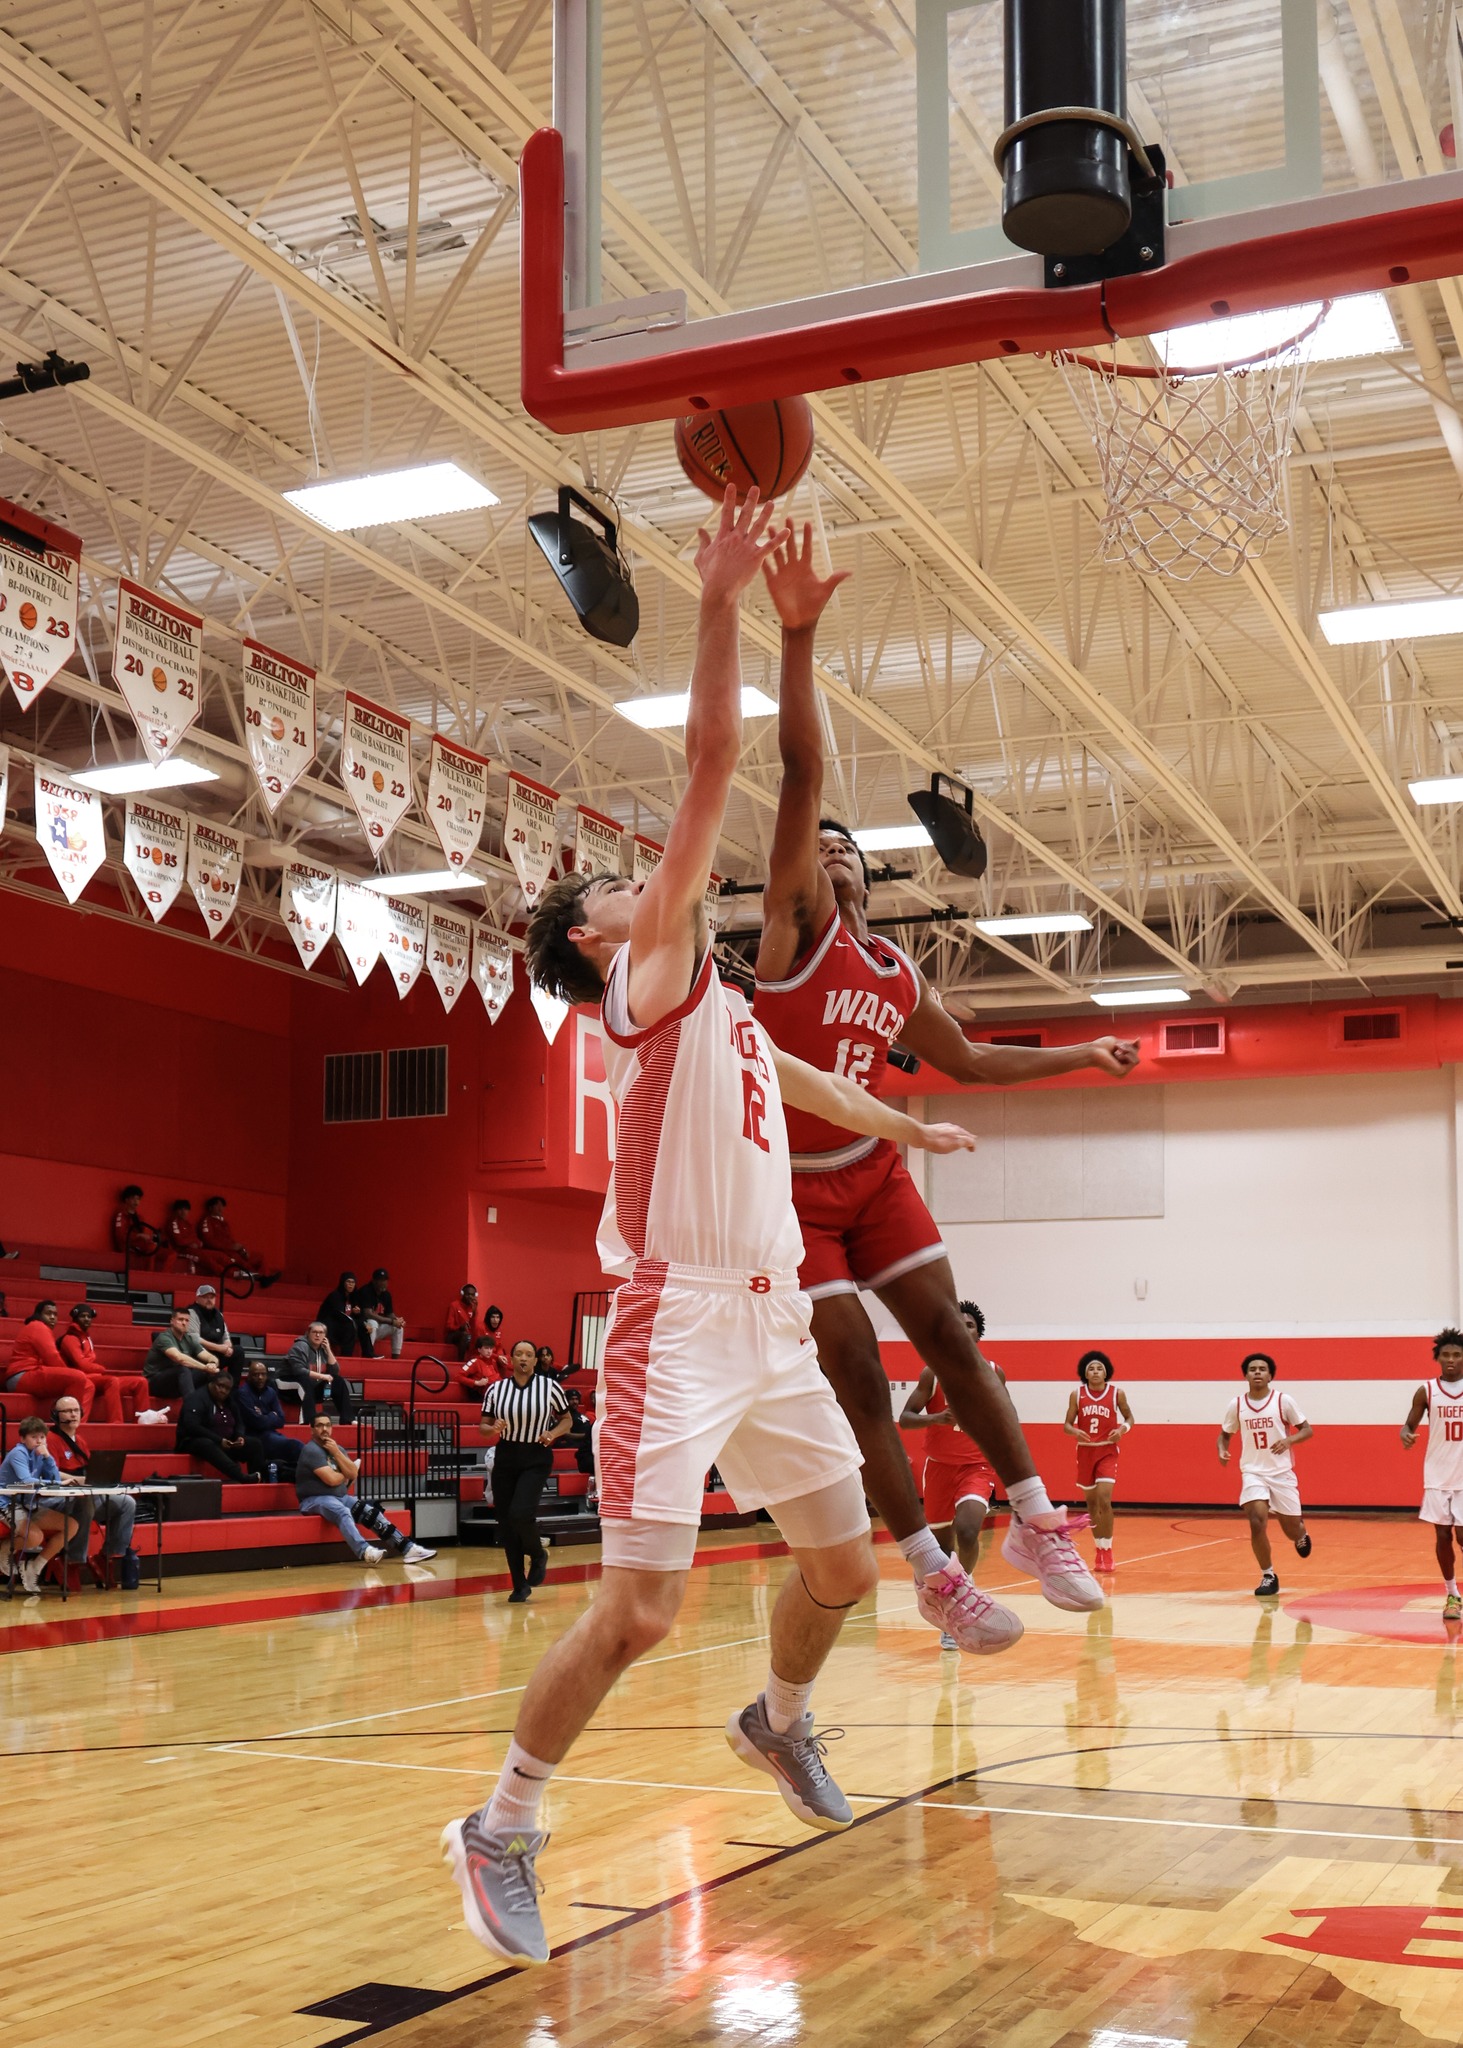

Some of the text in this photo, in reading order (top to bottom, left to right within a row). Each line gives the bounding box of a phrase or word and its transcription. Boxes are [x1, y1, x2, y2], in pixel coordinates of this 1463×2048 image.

[8, 578, 53, 607] BI-DISTRICT
[17, 560, 69, 600] BASKETBALL
[46, 616, 70, 638] 23
[129, 597, 192, 643] BELTON
[0, 624, 50, 653] CHAMPIONS
[125, 615, 195, 661] BOYS BASKETBALL
[122, 635, 198, 679] DISTRICT CO-CHAMPS
[12, 671, 34, 691] B
[124, 654, 194, 700] 20 22
[250, 652, 308, 693] BELTON
[245, 671, 306, 710] BOYS BASKETBALL
[246, 706, 307, 747] 20 21
[353, 706, 403, 743] BELTON
[350, 726, 404, 763] GIRLS BASKETBALL
[440, 747, 483, 777] BELTON
[40, 778, 92, 805] BELTON
[266, 775, 282, 794] B
[352, 761, 405, 799] 20 22
[437, 762, 485, 794] VOLLEYBALL
[365, 793, 388, 810] FINALIST
[437, 794, 481, 824] 20 17
[515, 782, 553, 812] BELTON
[133, 802, 181, 829] BELTON
[512, 797, 555, 827] VOLLEYBALL
[526, 818, 542, 832] AREA
[130, 814, 185, 841] BASKETBALL
[196, 823, 238, 851] BELTON
[368, 821, 384, 838] B
[583, 816, 618, 843] BELTON
[193, 836, 241, 863] BASKETBLL
[512, 828, 552, 856] 20 17
[580, 830, 620, 857] VOLLEYBALL
[135, 844, 177, 868] 19 85
[449, 851, 464, 866] B
[582, 859, 593, 873] 20
[198, 870, 236, 895] 19 91
[290, 862, 332, 881] BELTON
[147, 891, 162, 903] B
[388, 896, 423, 920] BELTON
[208, 909, 222, 922] B
[433, 914, 466, 935] BELTON
[302, 940, 315, 952] B
[388, 932, 424, 954] 20 02
[478, 928, 509, 947] BELTON
[433, 950, 445, 963] 20
[399, 972, 410, 983] B
[444, 986, 454, 997] B
[488, 999, 498, 1009] B
[822, 988, 905, 1042] WACO
[833, 1038, 876, 1090] 12
[741, 1068, 770, 1153] 12
[748, 1276, 771, 1294] B
[1082, 1404, 1110, 1419] WACO
[1244, 1417, 1274, 1430] TIGERS
[1089, 1417, 1099, 1434] 2
[1445, 1421, 1463, 1441] 10
[1253, 1431, 1268, 1450] 13
